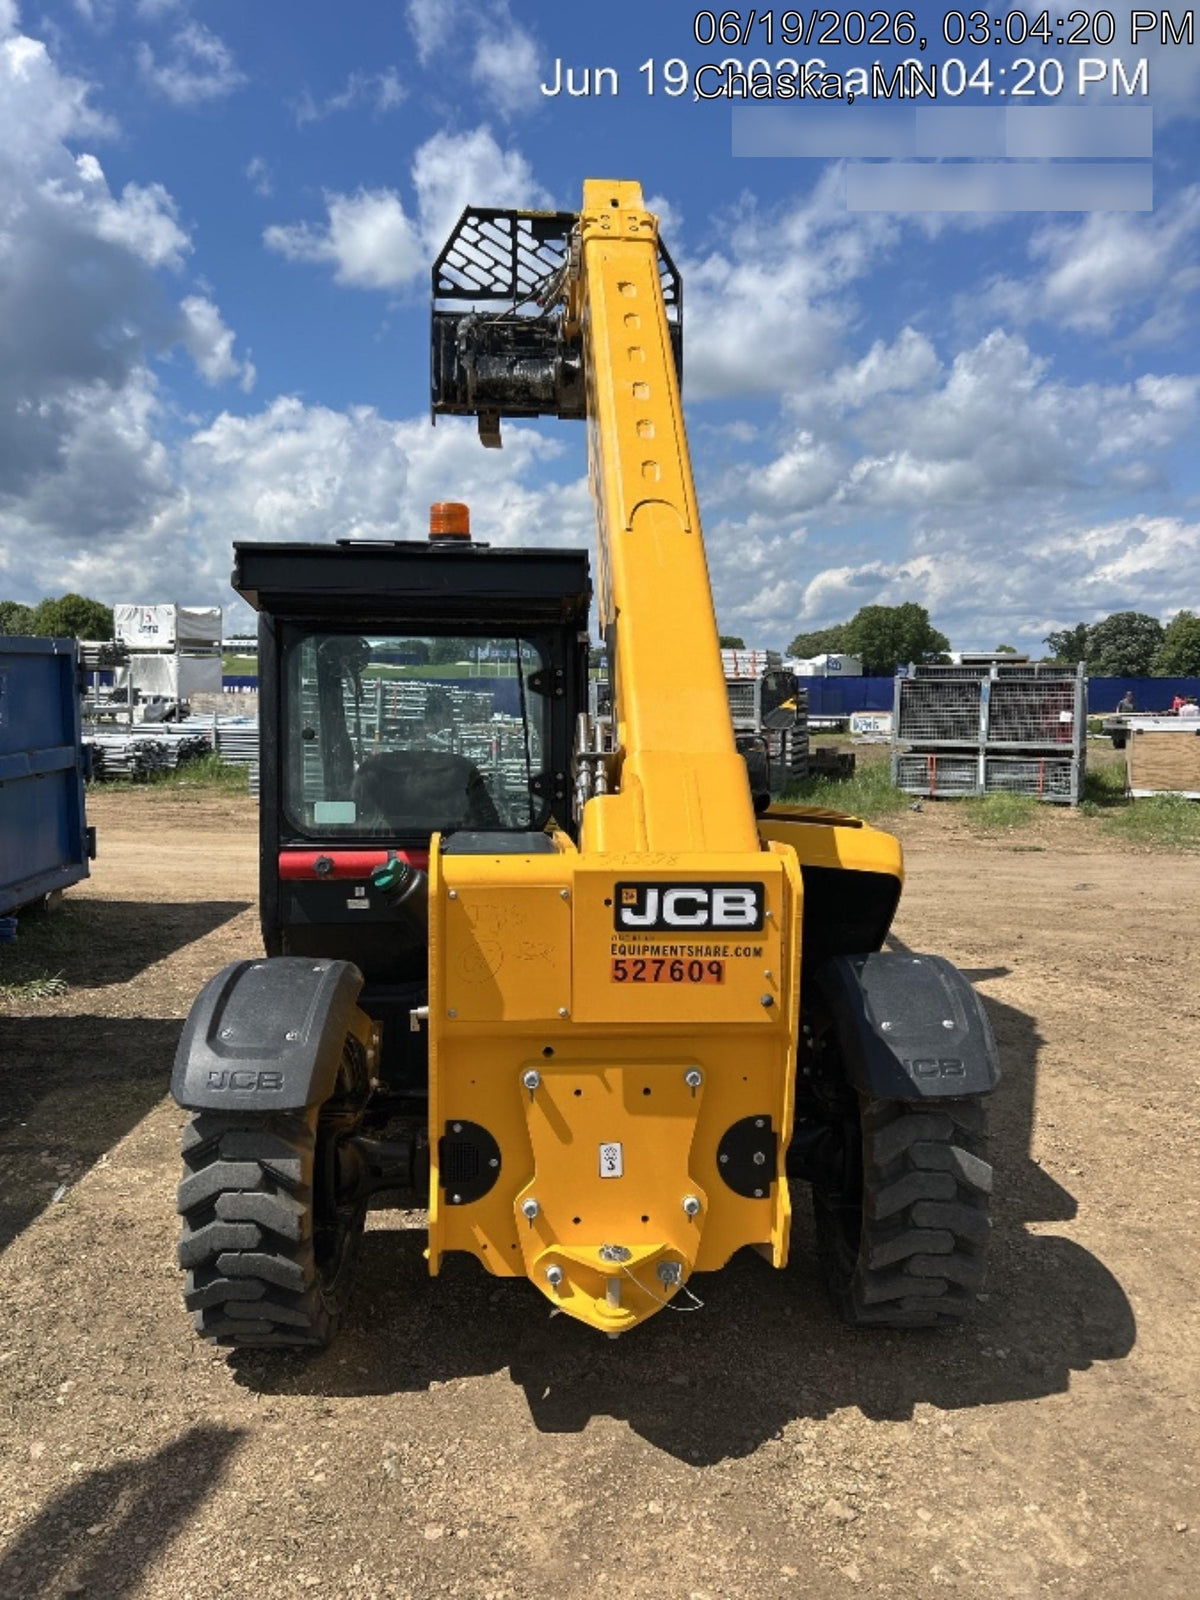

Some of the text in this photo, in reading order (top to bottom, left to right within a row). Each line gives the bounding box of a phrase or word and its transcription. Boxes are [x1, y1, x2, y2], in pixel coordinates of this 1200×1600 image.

[621, 888, 758, 926] JCB
[611, 944, 763, 957] EQUIPMENTSHARE.COM
[614, 959, 723, 982] 527609
[206, 1071, 284, 1092] JCB
